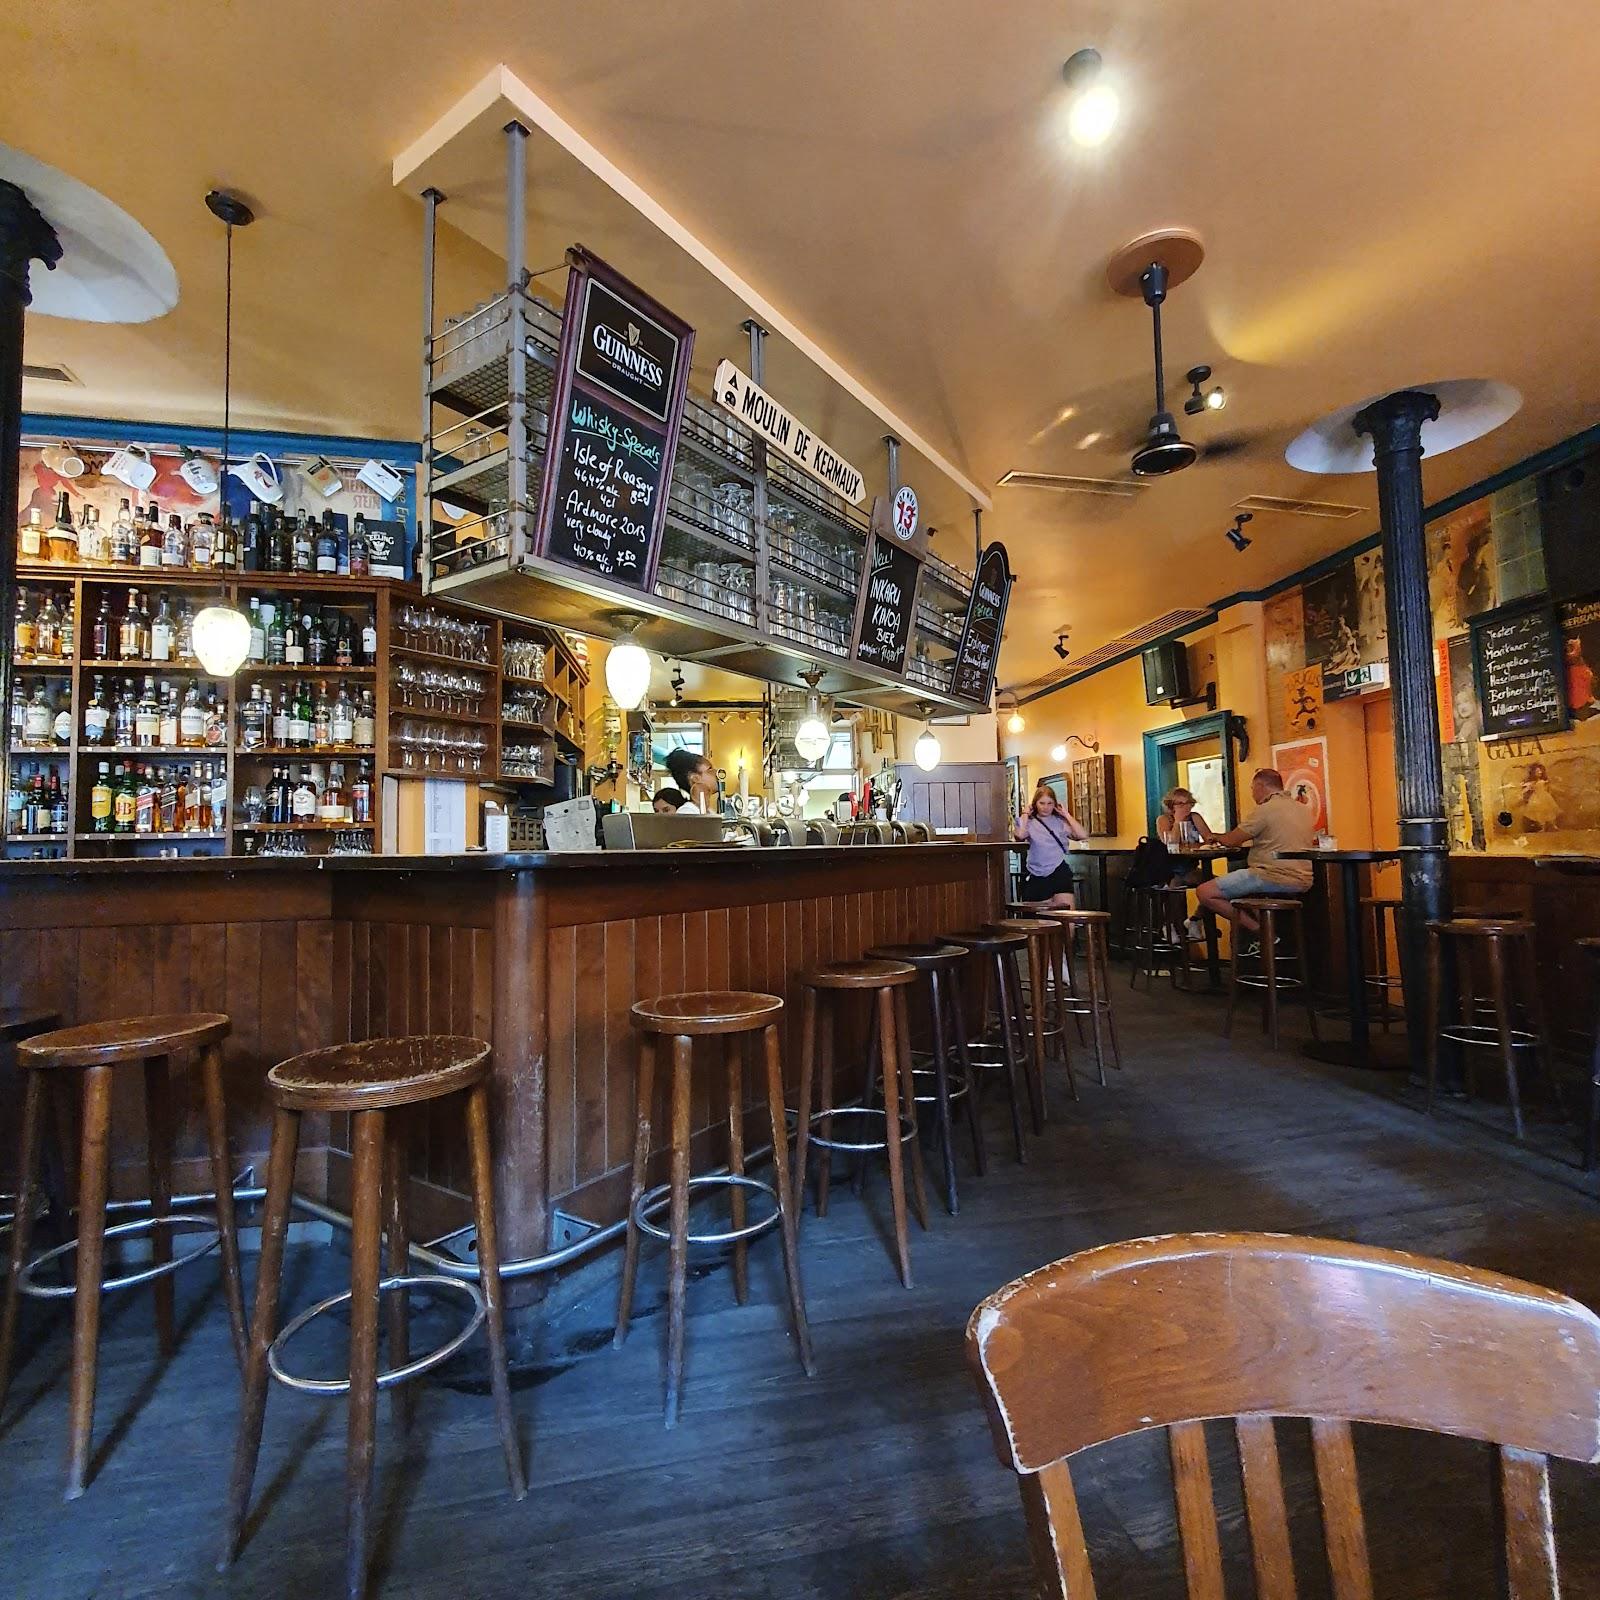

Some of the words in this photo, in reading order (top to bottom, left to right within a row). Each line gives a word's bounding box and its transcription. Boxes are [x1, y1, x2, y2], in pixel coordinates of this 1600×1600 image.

[593, 324, 663, 387] GUINNESS
[612, 362, 644, 385] DRAUGHT
[742, 386, 791, 446] MOULIN
[793, 428, 811, 462] DE
[813, 445, 861, 501] KERMAUX
[574, 438, 598, 469] Isle
[599, 457, 613, 482] of
[614, 459, 654, 506] Raasay
[600, 493, 616, 509] 4cl
[606, 483, 620, 498] alc
[566, 489, 617, 530] Ardmore
[619, 517, 646, 543] 2013
[897, 501, 916, 529] 13
[573, 542, 594, 560] 40%
[595, 553, 610, 566] alc
[872, 543, 893, 568] Neu!
[870, 576, 901, 607] INKARU
[979, 582, 1001, 608] GUINNESS
[876, 628, 895, 648] BIER
[1486, 736, 1546, 760] GALA
